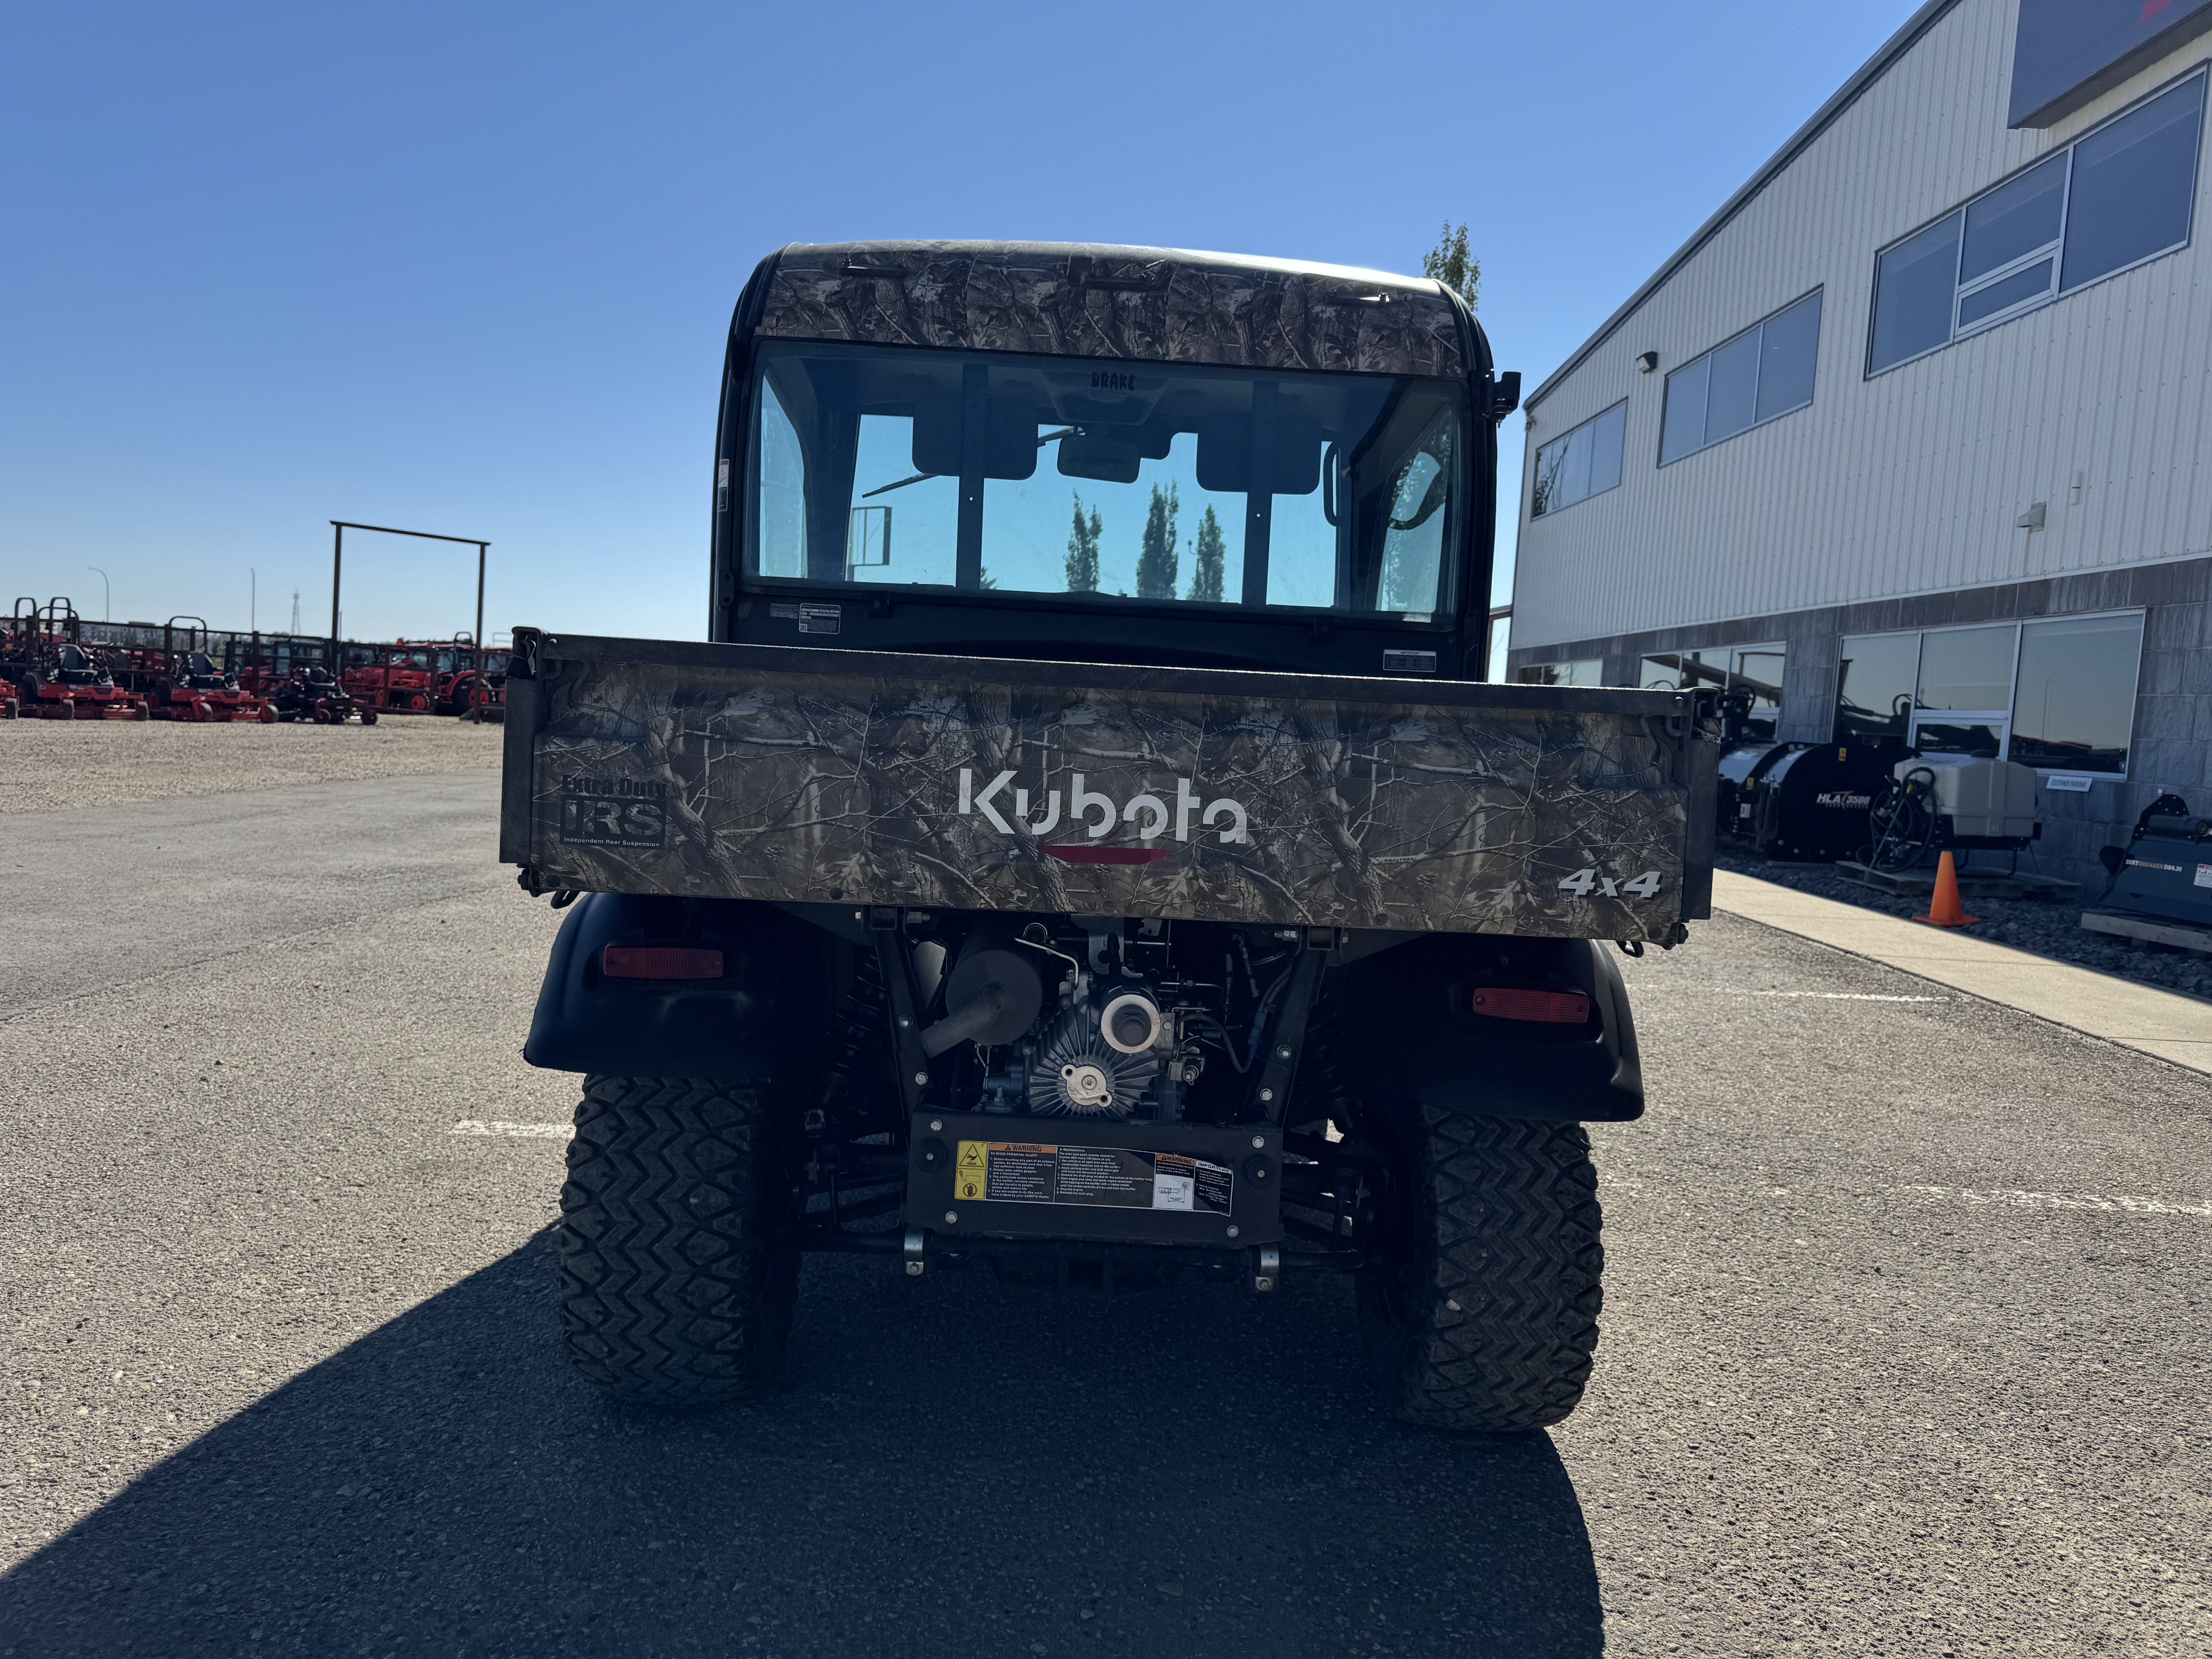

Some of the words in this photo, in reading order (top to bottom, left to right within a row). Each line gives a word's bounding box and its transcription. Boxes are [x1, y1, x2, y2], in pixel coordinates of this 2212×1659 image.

[1092, 371, 1135, 390] BRAKE
[562, 775, 613, 795] Extra
[619, 778, 667, 799] Duty
[1816, 793, 1841, 804] HLA
[565, 799, 663, 836] IRS
[958, 768, 1247, 843] Kubota
[1558, 869, 1662, 898] 4x4
[1198, 1162, 1228, 1172] IMPORTANT
